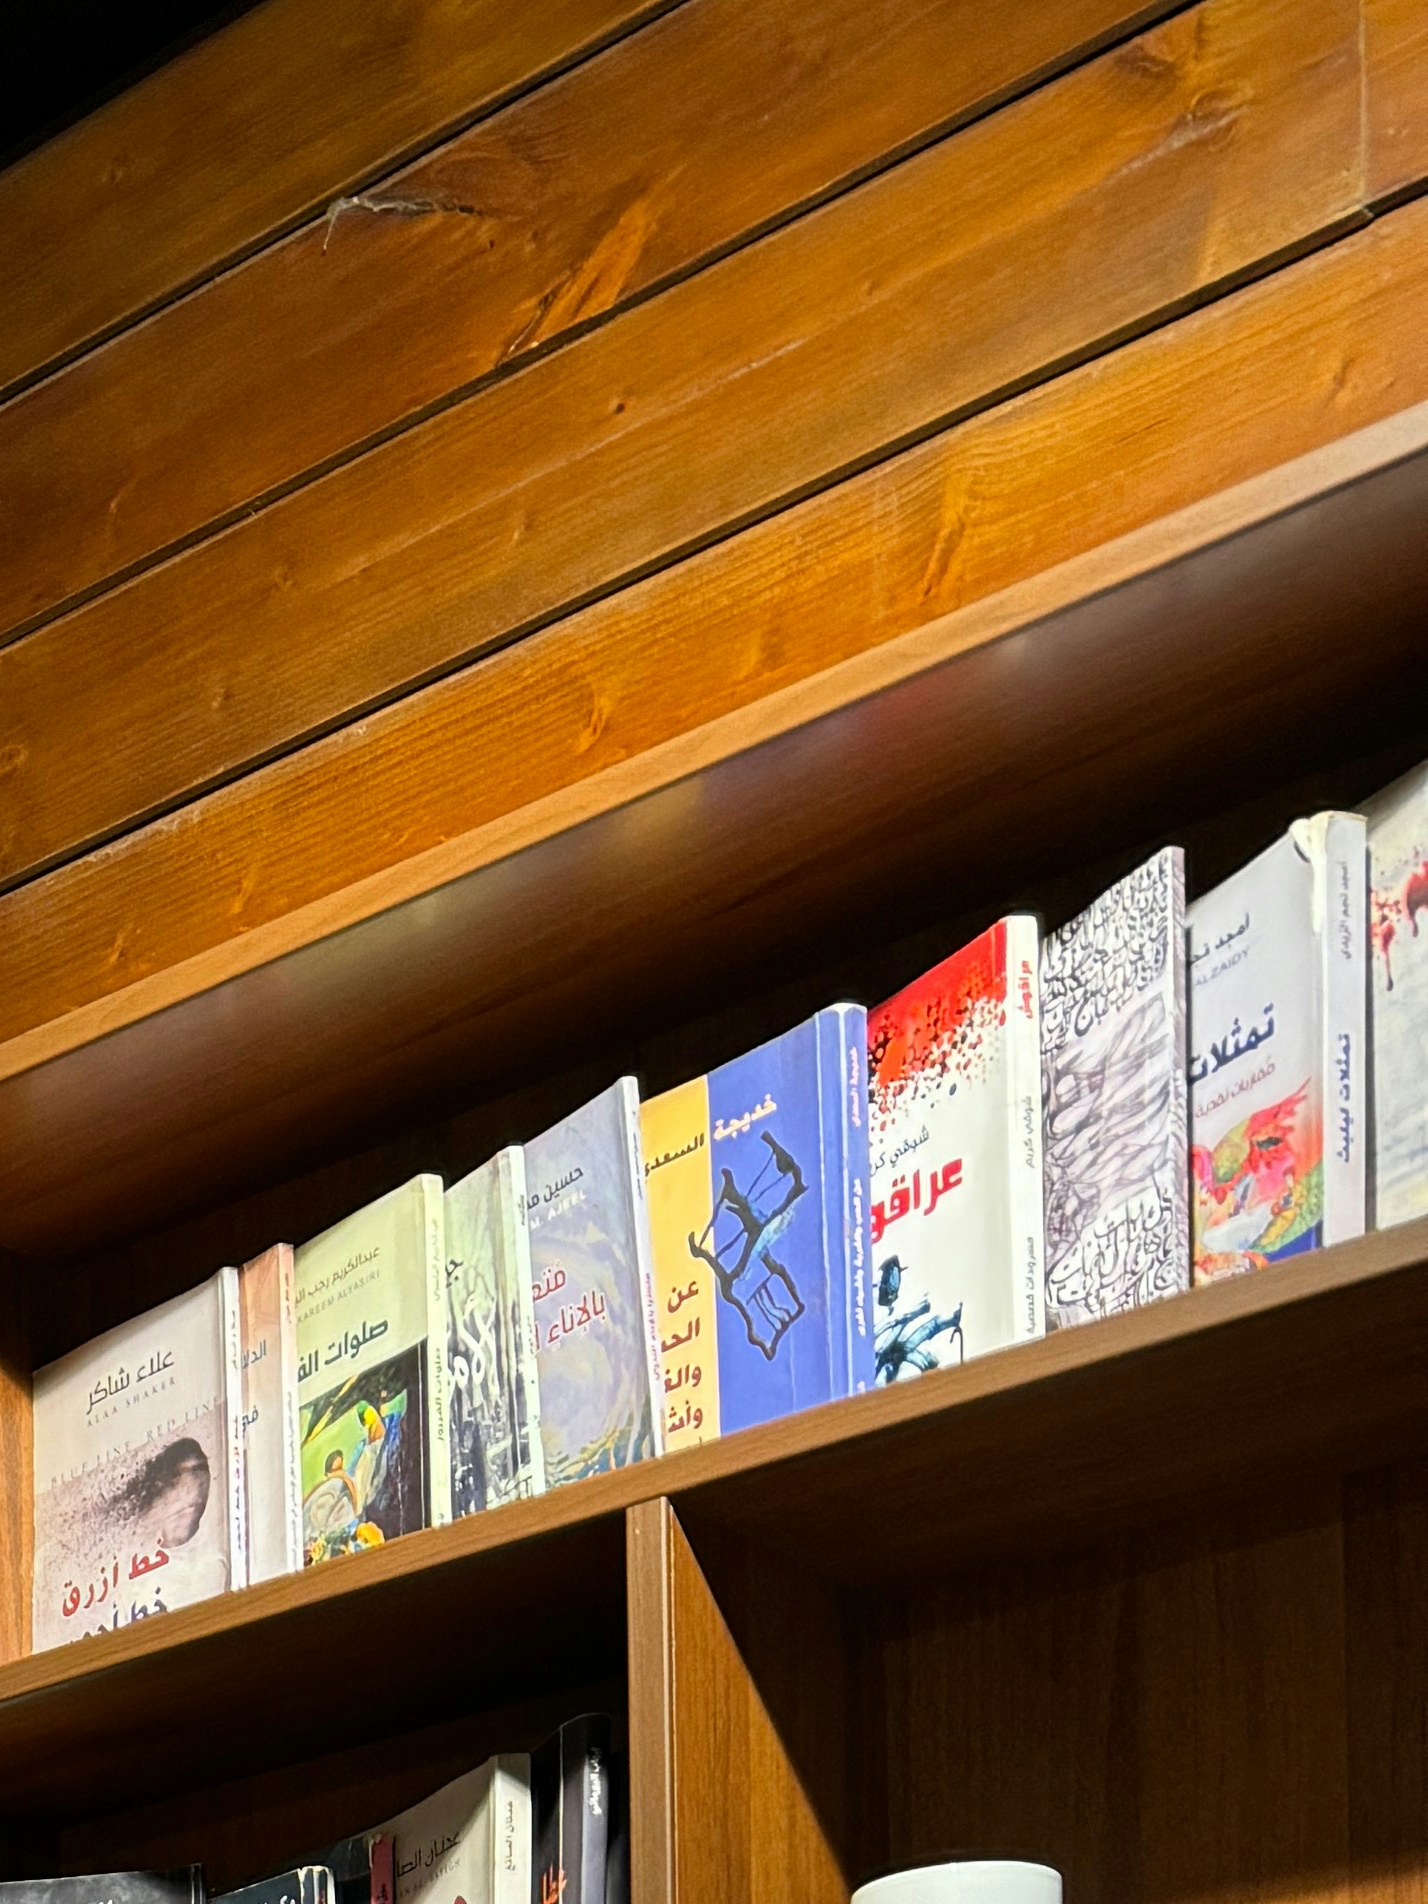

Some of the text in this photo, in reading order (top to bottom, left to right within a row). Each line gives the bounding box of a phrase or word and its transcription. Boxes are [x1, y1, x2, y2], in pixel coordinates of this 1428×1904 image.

[714, 1095, 777, 1140] خديجة
[890, 1125, 930, 1167] شوقي
[543, 1166, 584, 1203] حسين
[872, 1158, 964, 1245] عراقو
[668, 1277, 699, 1314] عن
[325, 1319, 389, 1360] صلوات
[86, 1351, 175, 1415] علاء شاكر
[61, 1536, 170, 1619] خط أزرق
